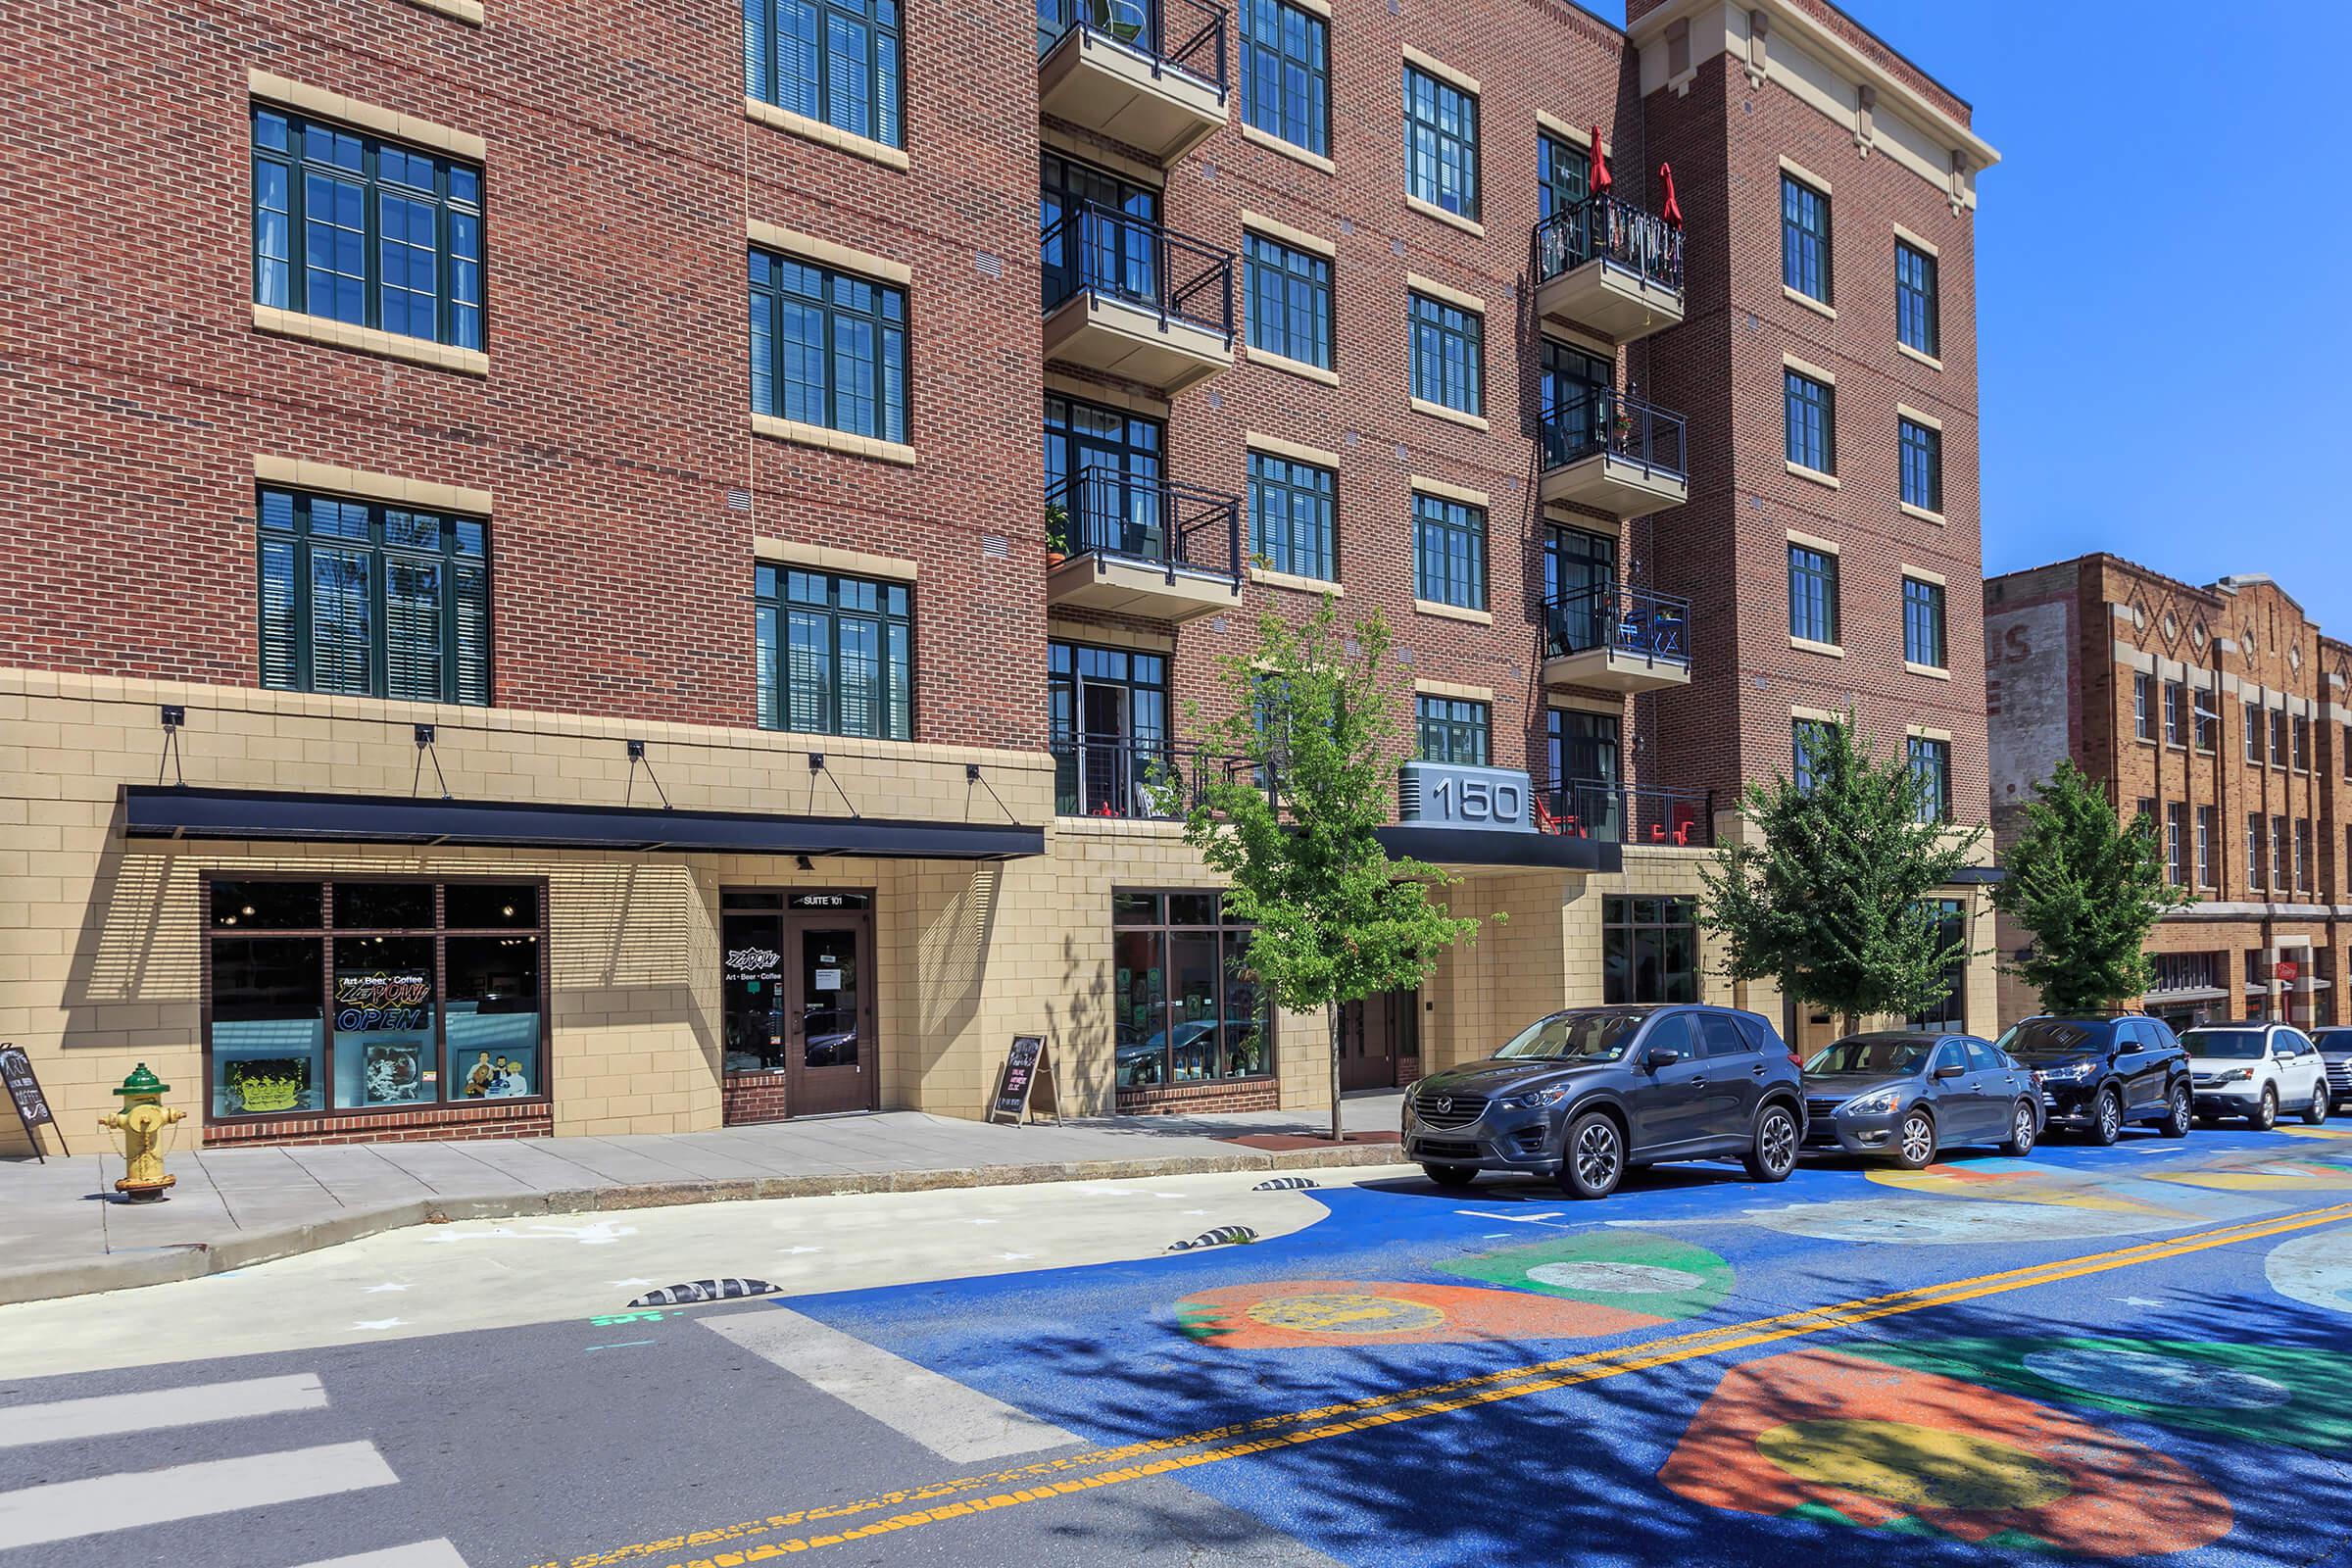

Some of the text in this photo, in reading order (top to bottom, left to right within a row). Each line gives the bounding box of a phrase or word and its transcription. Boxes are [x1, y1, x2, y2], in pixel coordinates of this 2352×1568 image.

[1434, 777, 1521, 821] 150
[804, 896, 843, 906] SUITE 101
[343, 975, 423, 986] Art Beer Coffee
[337, 1007, 421, 1031] OPEN
